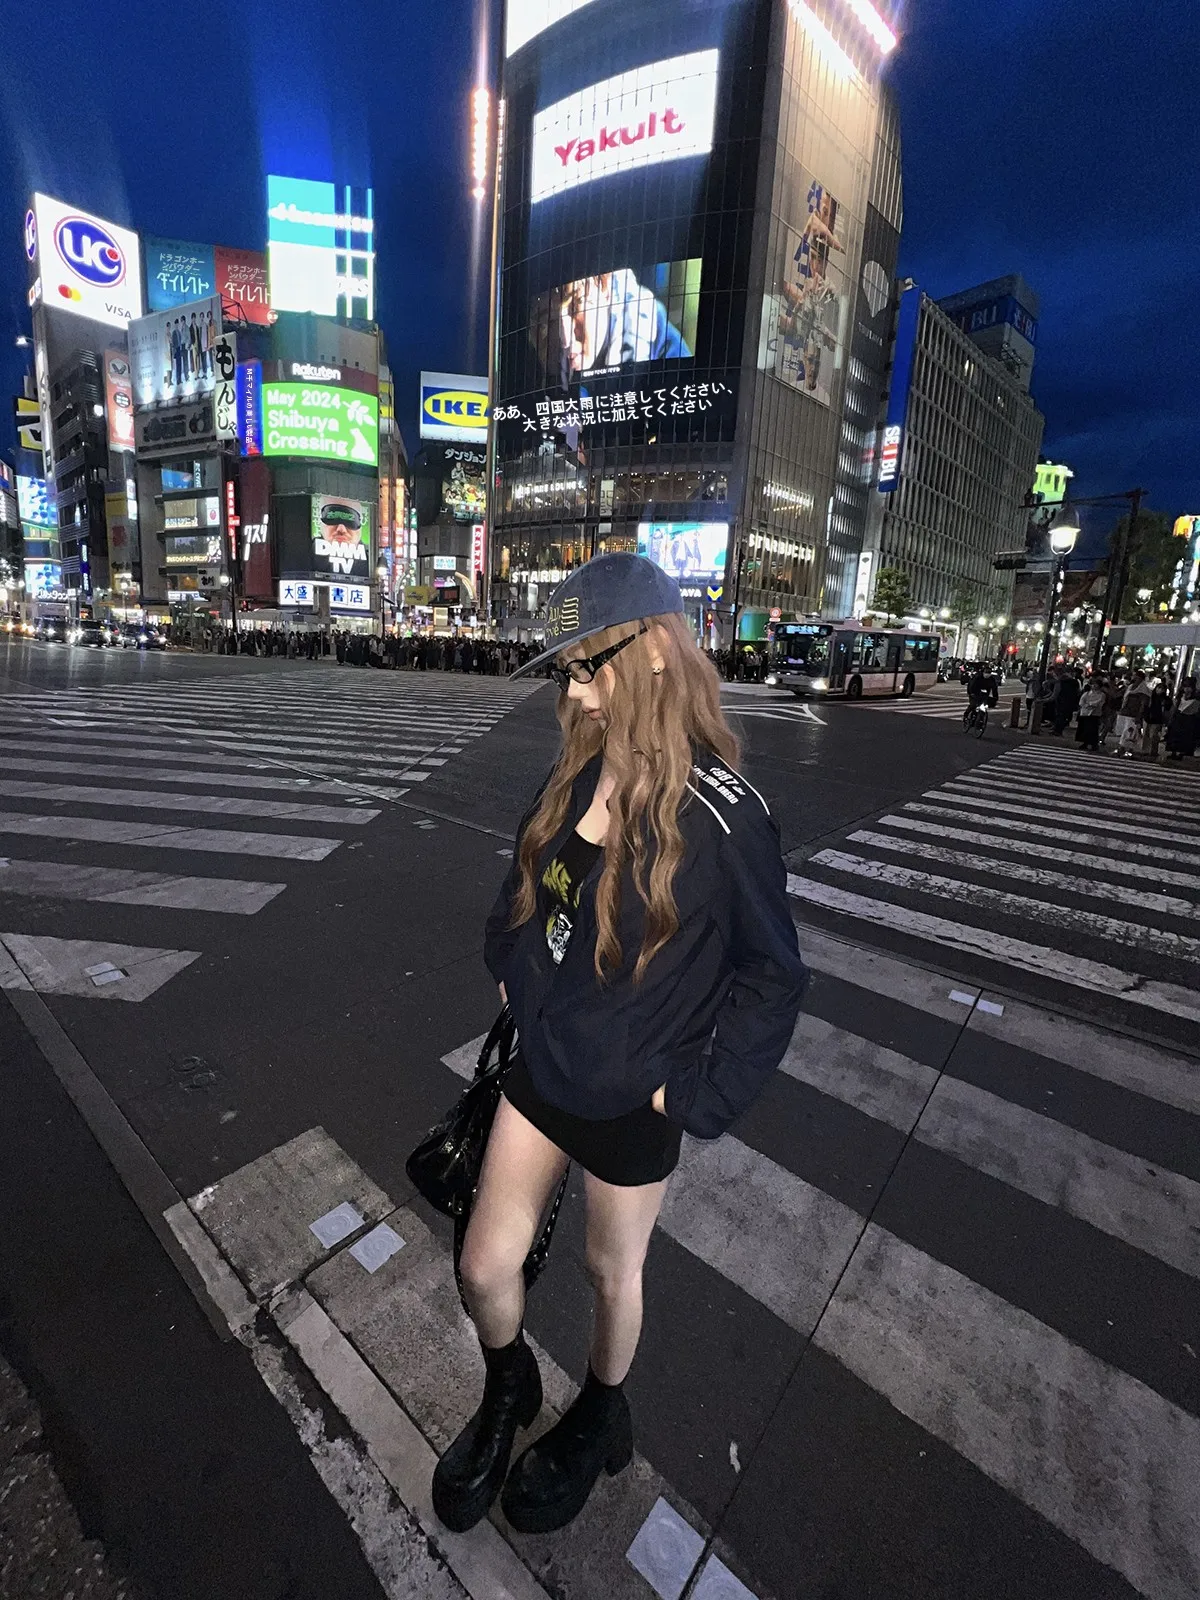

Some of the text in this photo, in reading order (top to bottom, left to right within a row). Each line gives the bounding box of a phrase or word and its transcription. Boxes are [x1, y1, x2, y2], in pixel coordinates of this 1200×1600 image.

[554, 108, 685, 166] Yakult
[63, 227, 119, 275] UC
[160, 252, 205, 265] ドラゴンホー
[227, 264, 267, 275] ドラゴンホー
[104, 302, 132, 320] VISA
[292, 362, 341, 380] Rakuten
[215, 337, 237, 436] もんじゃ
[267, 389, 341, 410] May 2024
[268, 409, 339, 433] Shibuya
[523, 399, 712, 433] 大きな状況に加えてください
[268, 430, 348, 457] Crossing
[880, 426, 900, 481] SEIBU
[315, 538, 367, 560] DMM
[329, 556, 354, 574] TV
[284, 585, 364, 604] 大盛 書店
